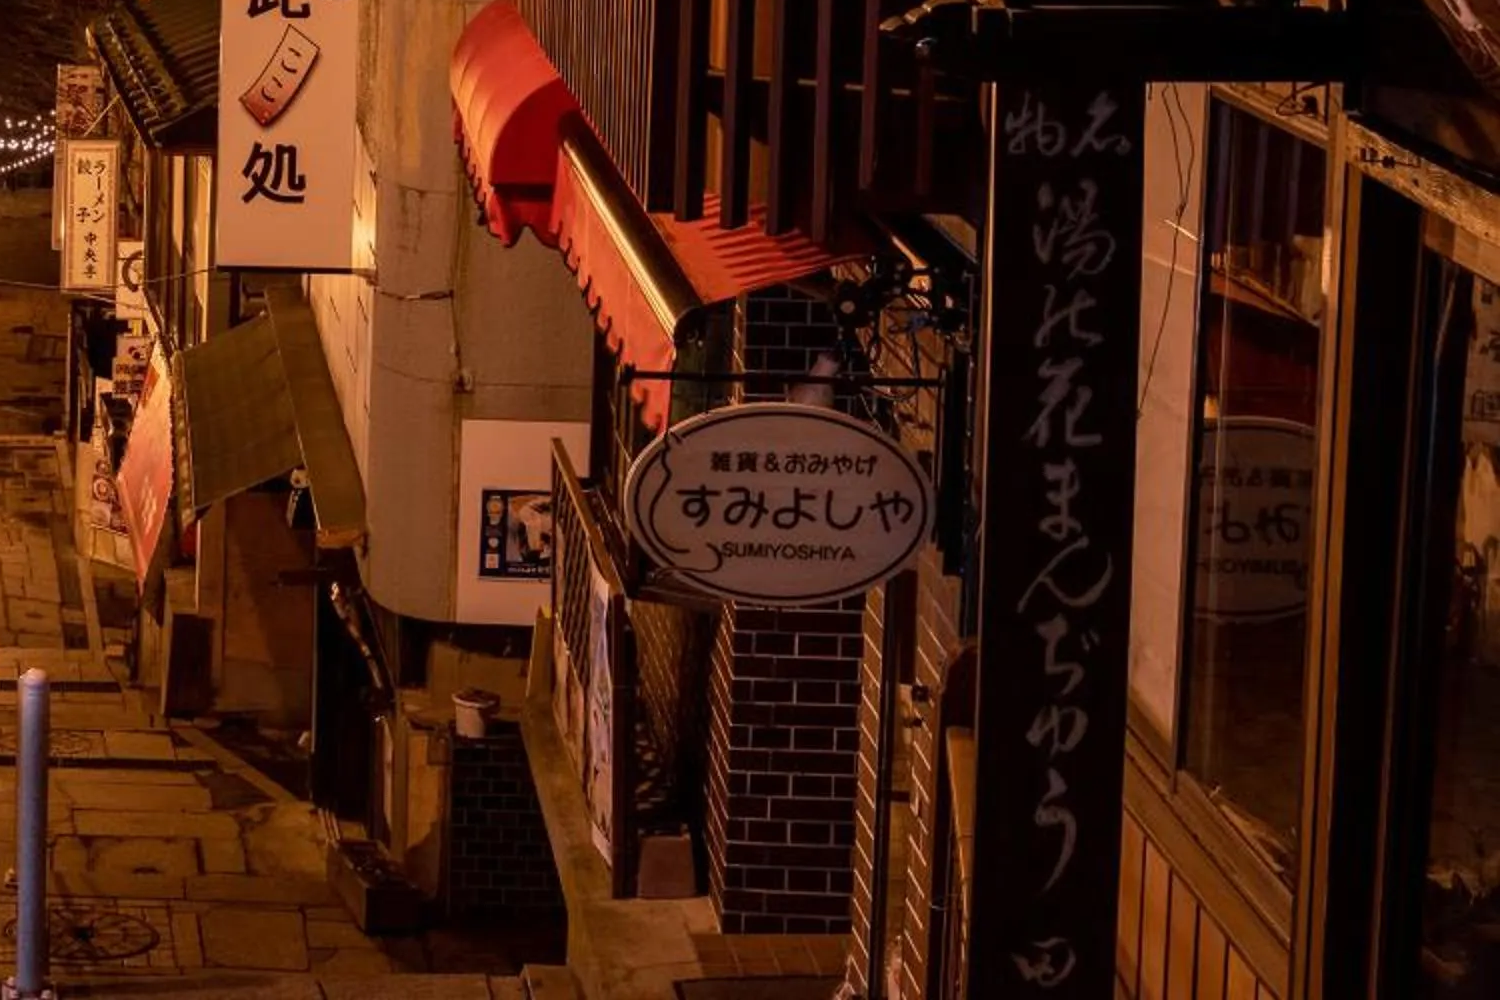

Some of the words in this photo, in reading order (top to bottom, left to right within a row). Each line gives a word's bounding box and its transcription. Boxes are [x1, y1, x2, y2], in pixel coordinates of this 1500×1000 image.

[261, 47, 301, 103] ここ
[76, 158, 92, 223] 餃子
[92, 160, 107, 223] ラーメン
[83, 231, 98, 279] 中央亭
[675, 485, 914, 532] すみよしや
[722, 543, 857, 561] SUMIYOSHIYA
